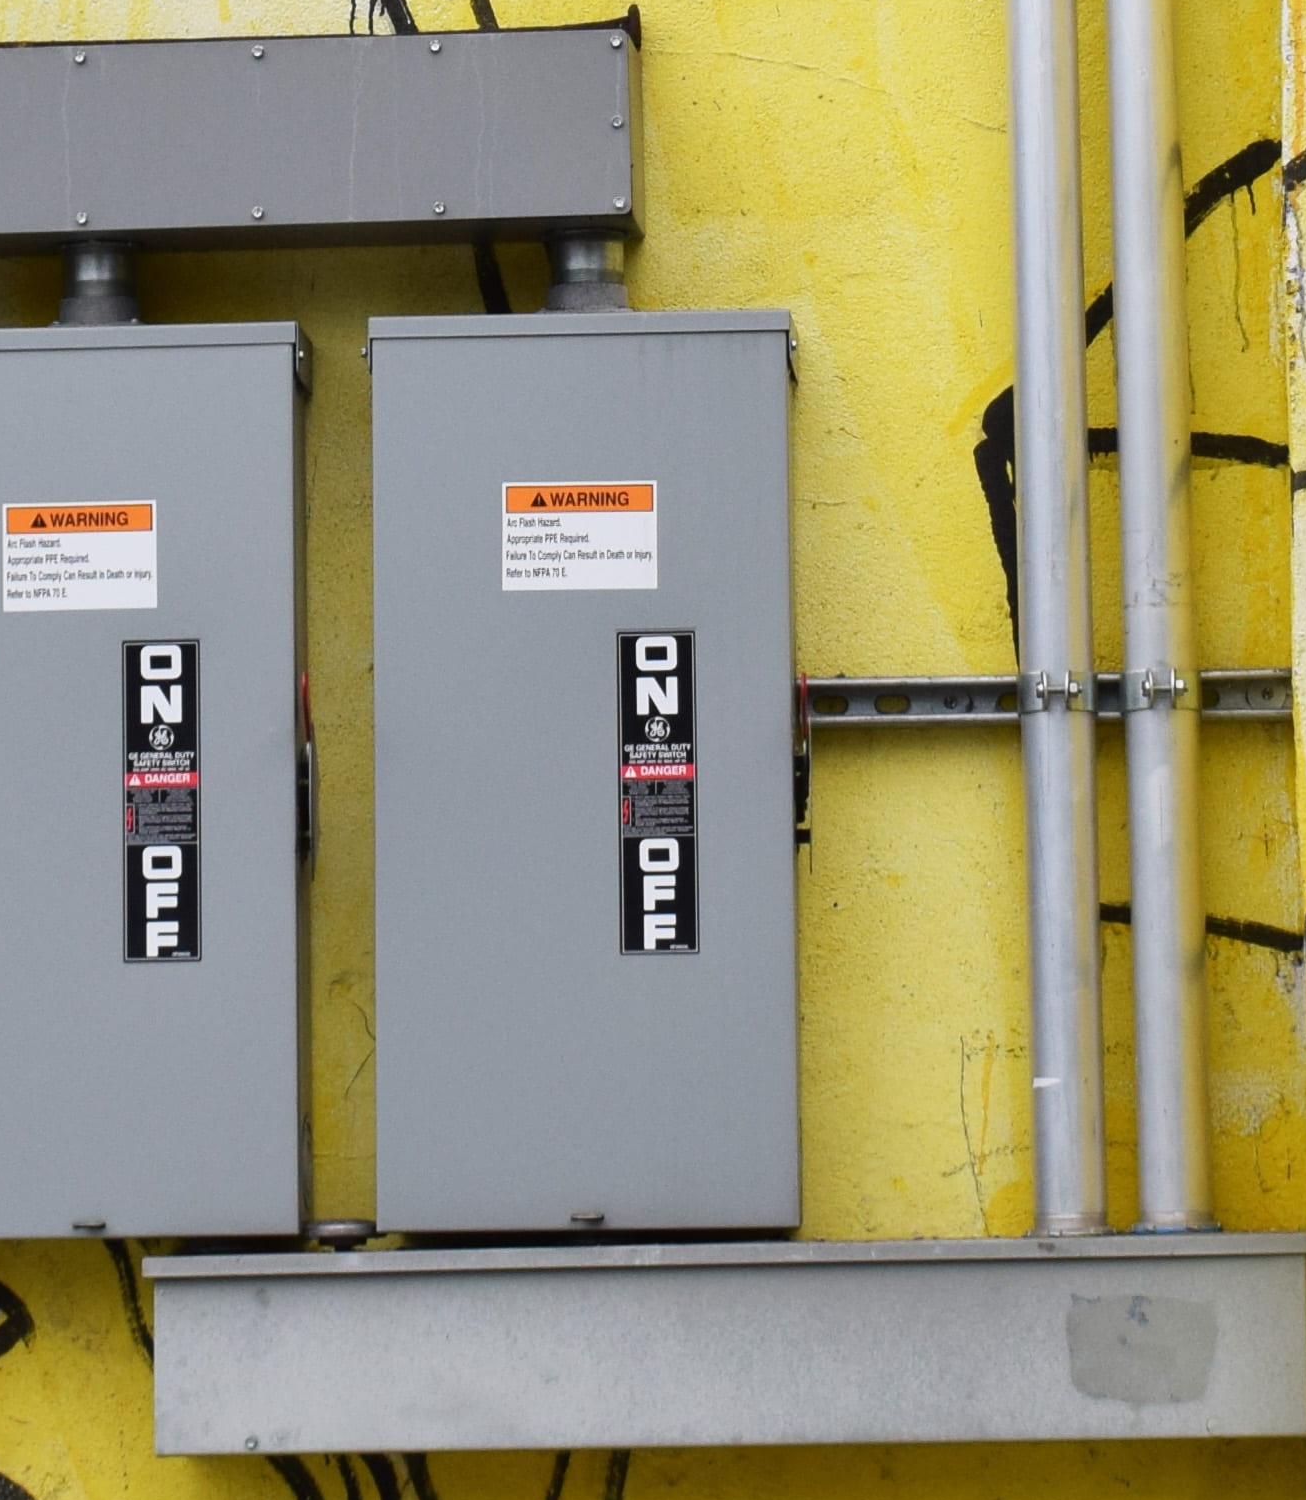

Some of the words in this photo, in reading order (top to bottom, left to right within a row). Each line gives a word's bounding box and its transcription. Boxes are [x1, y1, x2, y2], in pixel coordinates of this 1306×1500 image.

[550, 491, 630, 507] WARNING
[50, 511, 129, 528] WARNING
[507, 518, 517, 527] Arc
[553, 568, 559, 577] 70
[636, 636, 678, 715] ON
[141, 644, 182, 724] ON
[635, 743, 670, 753] GENERAL
[671, 743, 692, 752] DUTY
[140, 752, 174, 761] GENERAL
[174, 751, 195, 760] DUTY
[629, 751, 657, 760] SAFETY
[658, 751, 687, 760] SWITCH
[133, 759, 161, 768] SAFETY
[162, 759, 190, 768] SWITCH
[641, 765, 686, 776] DANGER
[144, 773, 190, 784] DANGER
[639, 838, 680, 950] OFF
[142, 845, 182, 957] OFF
